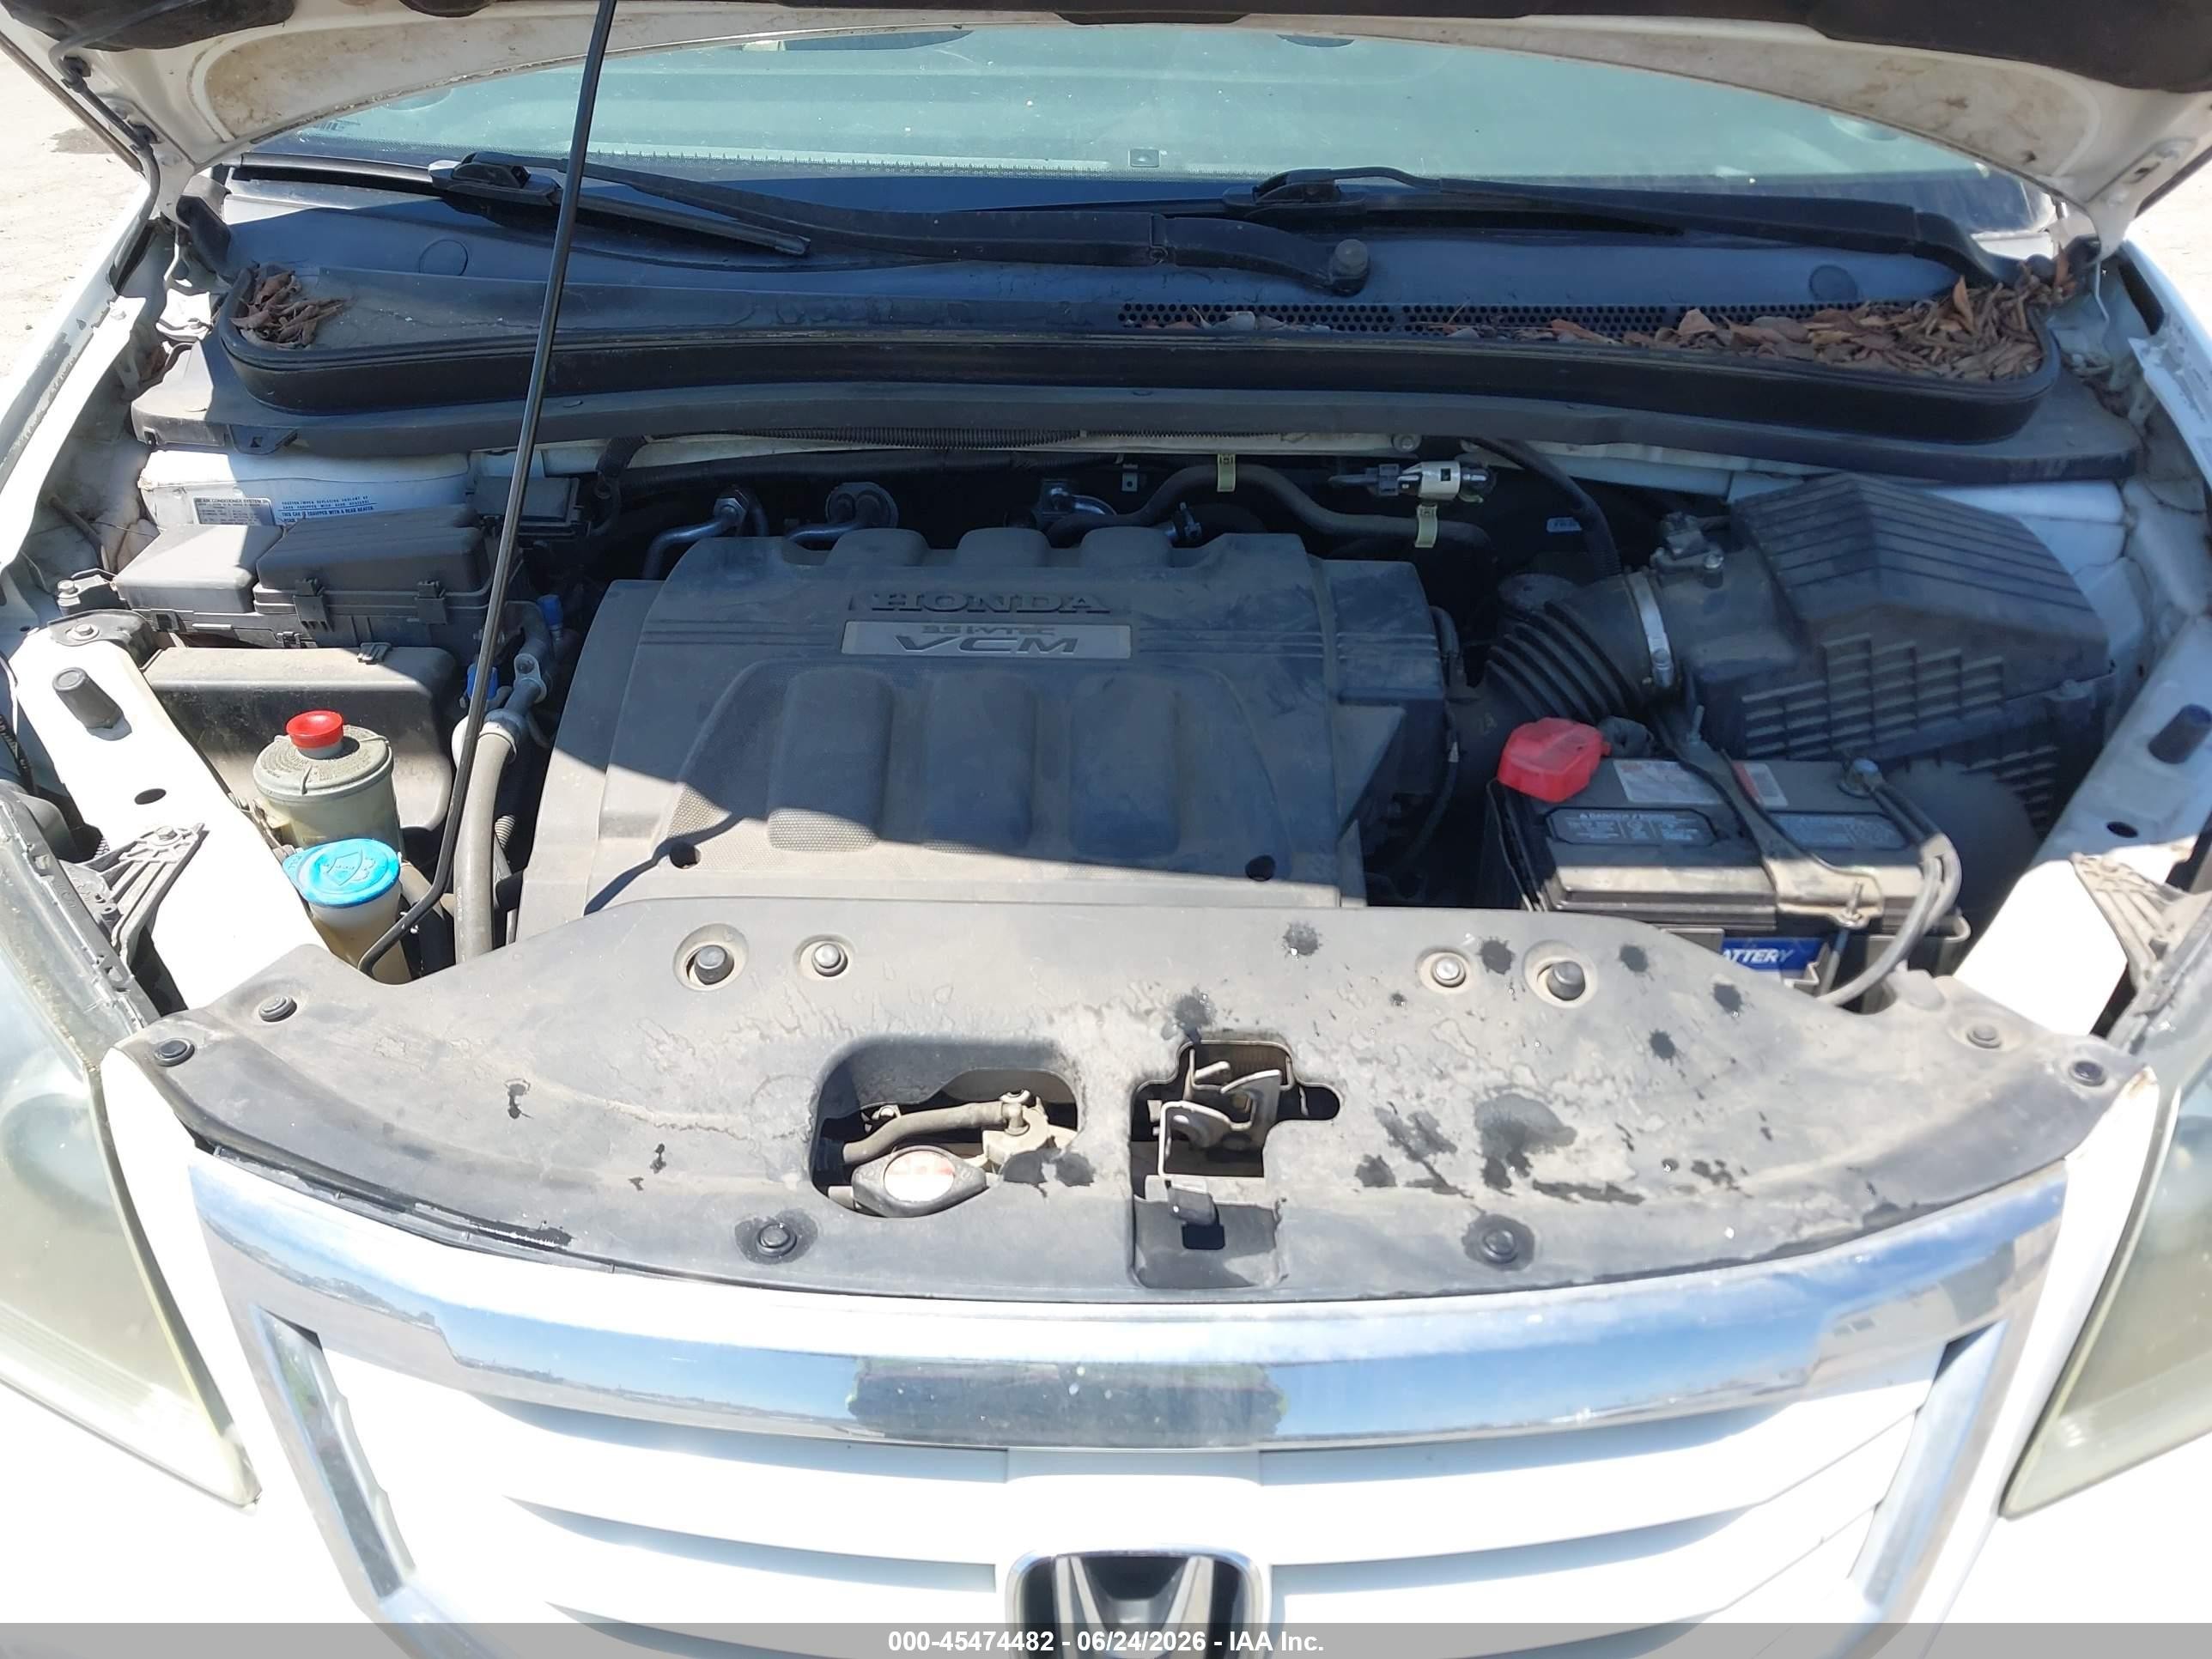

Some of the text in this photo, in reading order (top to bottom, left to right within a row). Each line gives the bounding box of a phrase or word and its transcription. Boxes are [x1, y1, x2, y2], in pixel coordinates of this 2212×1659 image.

[870, 592, 1112, 613] HONDA
[894, 635, 1079, 653] VCM
[1722, 948, 1794, 963] ATTERY
